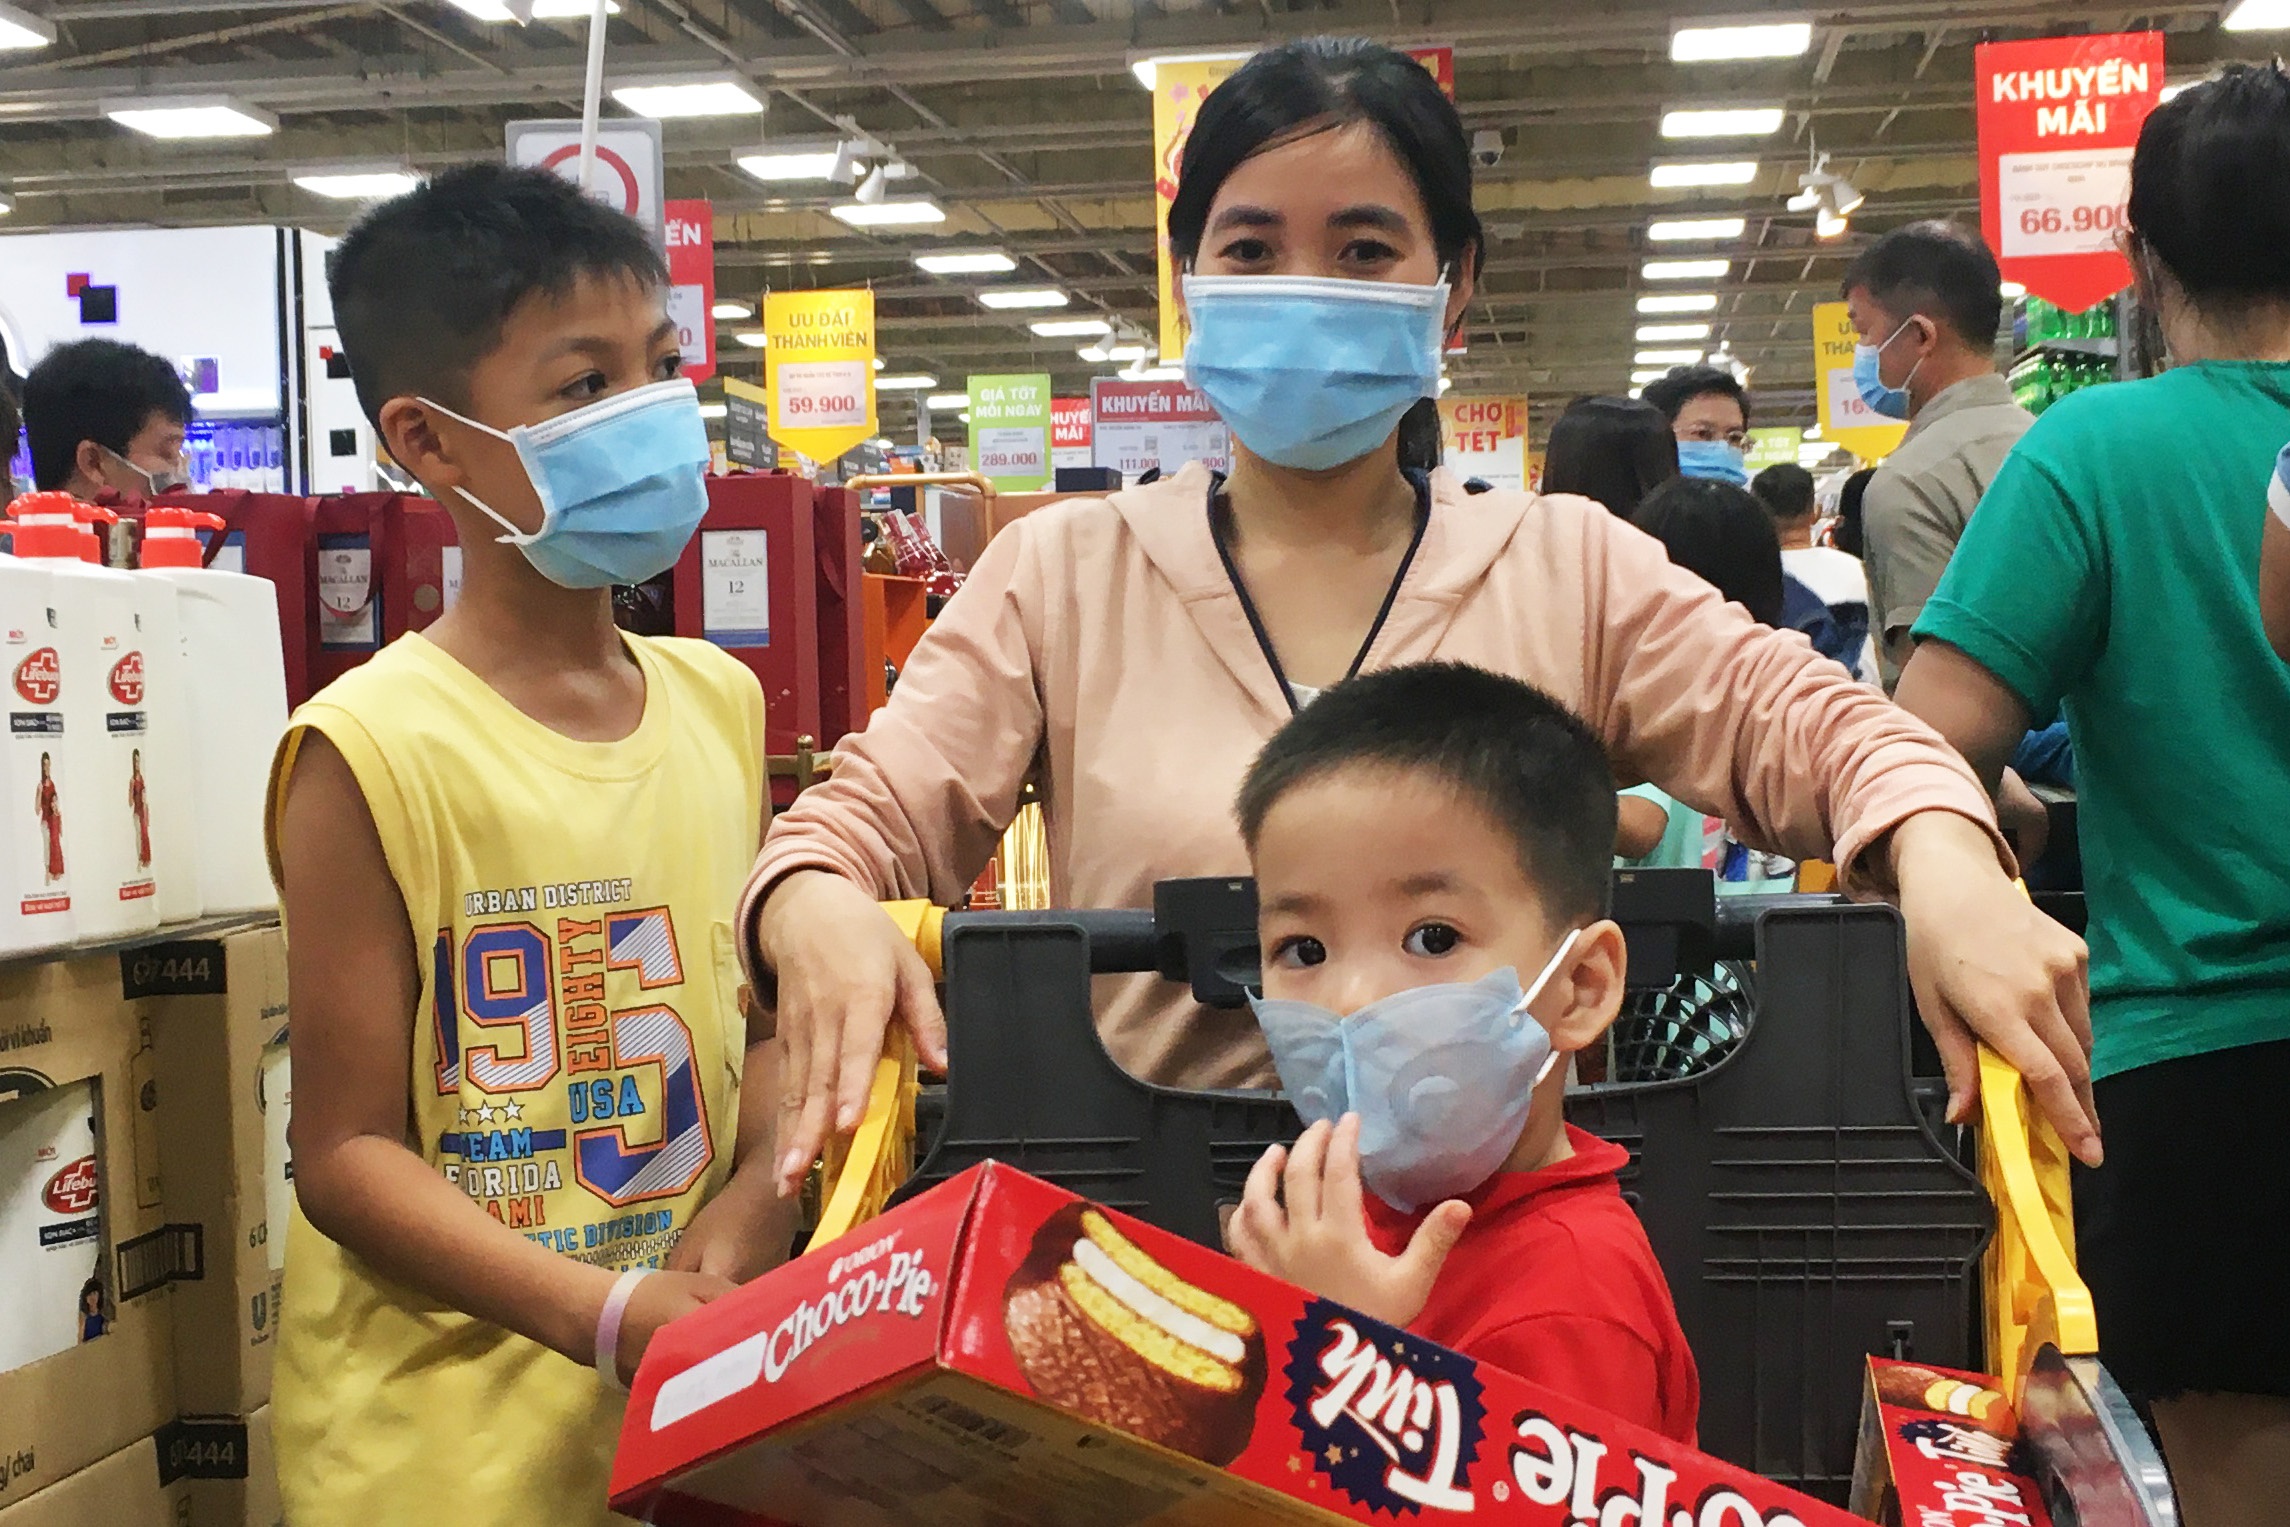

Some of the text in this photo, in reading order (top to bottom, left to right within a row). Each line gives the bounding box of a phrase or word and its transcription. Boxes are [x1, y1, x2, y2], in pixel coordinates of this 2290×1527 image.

[1993, 58, 2148, 103] KHUYẾN
[2036, 99, 2106, 137] MÃI
[789, 395, 856, 414] 59.900
[980, 386, 1006, 402] GIÁ
[1101, 389, 1171, 413] KHUYẾN
[981, 452, 1037, 466] 289.000
[708, 557, 763, 568] MACALLAN
[729, 580, 745, 594] 12
[336, 596, 351, 610] 12
[465, 878, 632, 917] URBAN DISTRICT
[557, 917, 611, 1076] EIGHTY
[568, 1075, 645, 1125] USA
[583, 1209, 672, 1248] DIVISION
